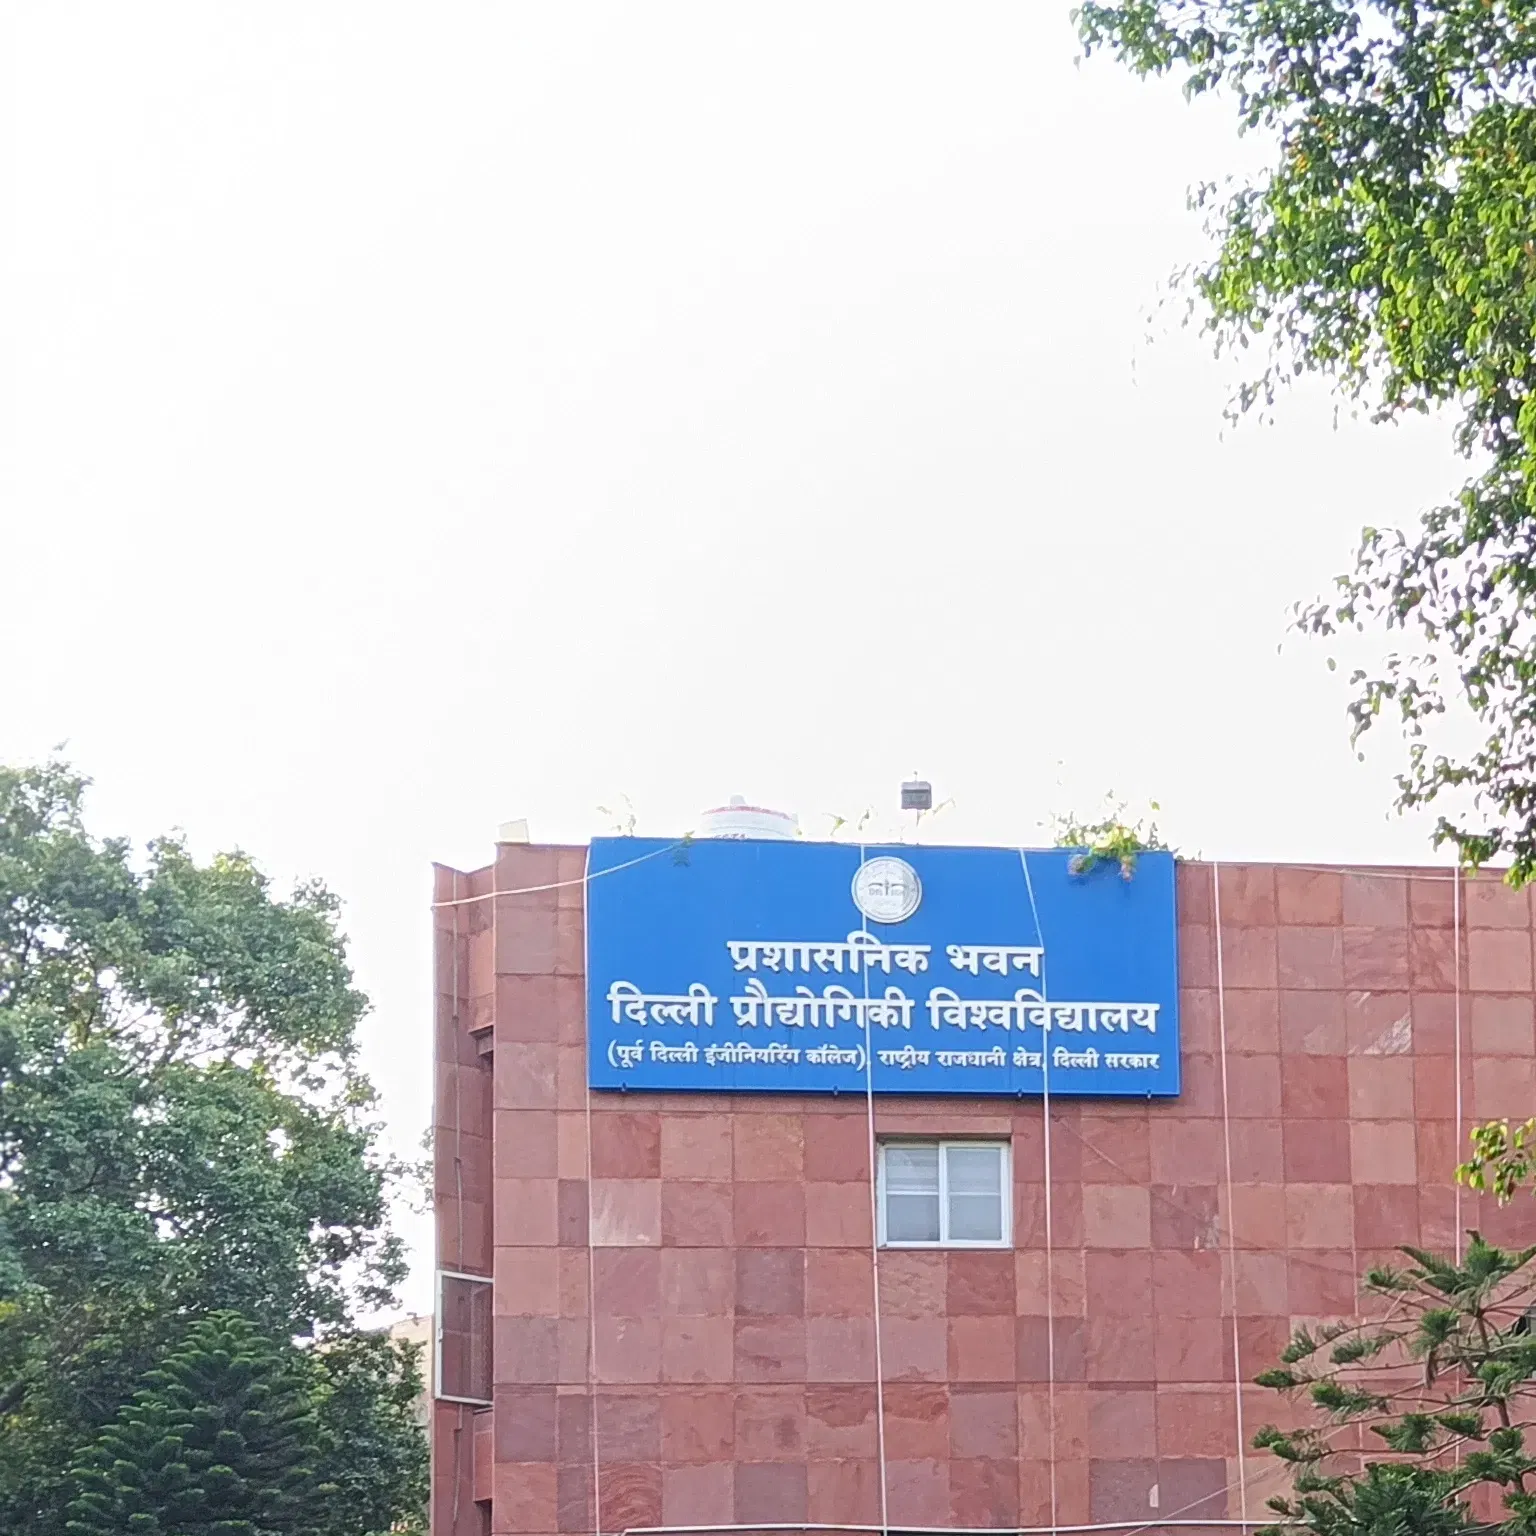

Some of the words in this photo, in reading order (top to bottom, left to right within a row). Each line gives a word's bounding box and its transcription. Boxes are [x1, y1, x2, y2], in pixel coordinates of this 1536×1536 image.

[727, 930, 931, 974] प्रशासनिक
[946, 944, 1043, 977] भवन
[607, 980, 718, 1027] दिल्ली
[730, 977, 914, 1029] प्रौद्योगिकी
[926, 987, 1160, 1032] विश्वविद्यालय
[608, 1039, 644, 1068] (पूर्व
[650, 1041, 699, 1065] दिल्ली
[877, 1045, 931, 1069] राष्ट्रीय
[935, 1046, 1006, 1067] राजधानी
[1053, 1047, 1099, 1069] दिल्ली
[1105, 1053, 1159, 1069] सरकार
